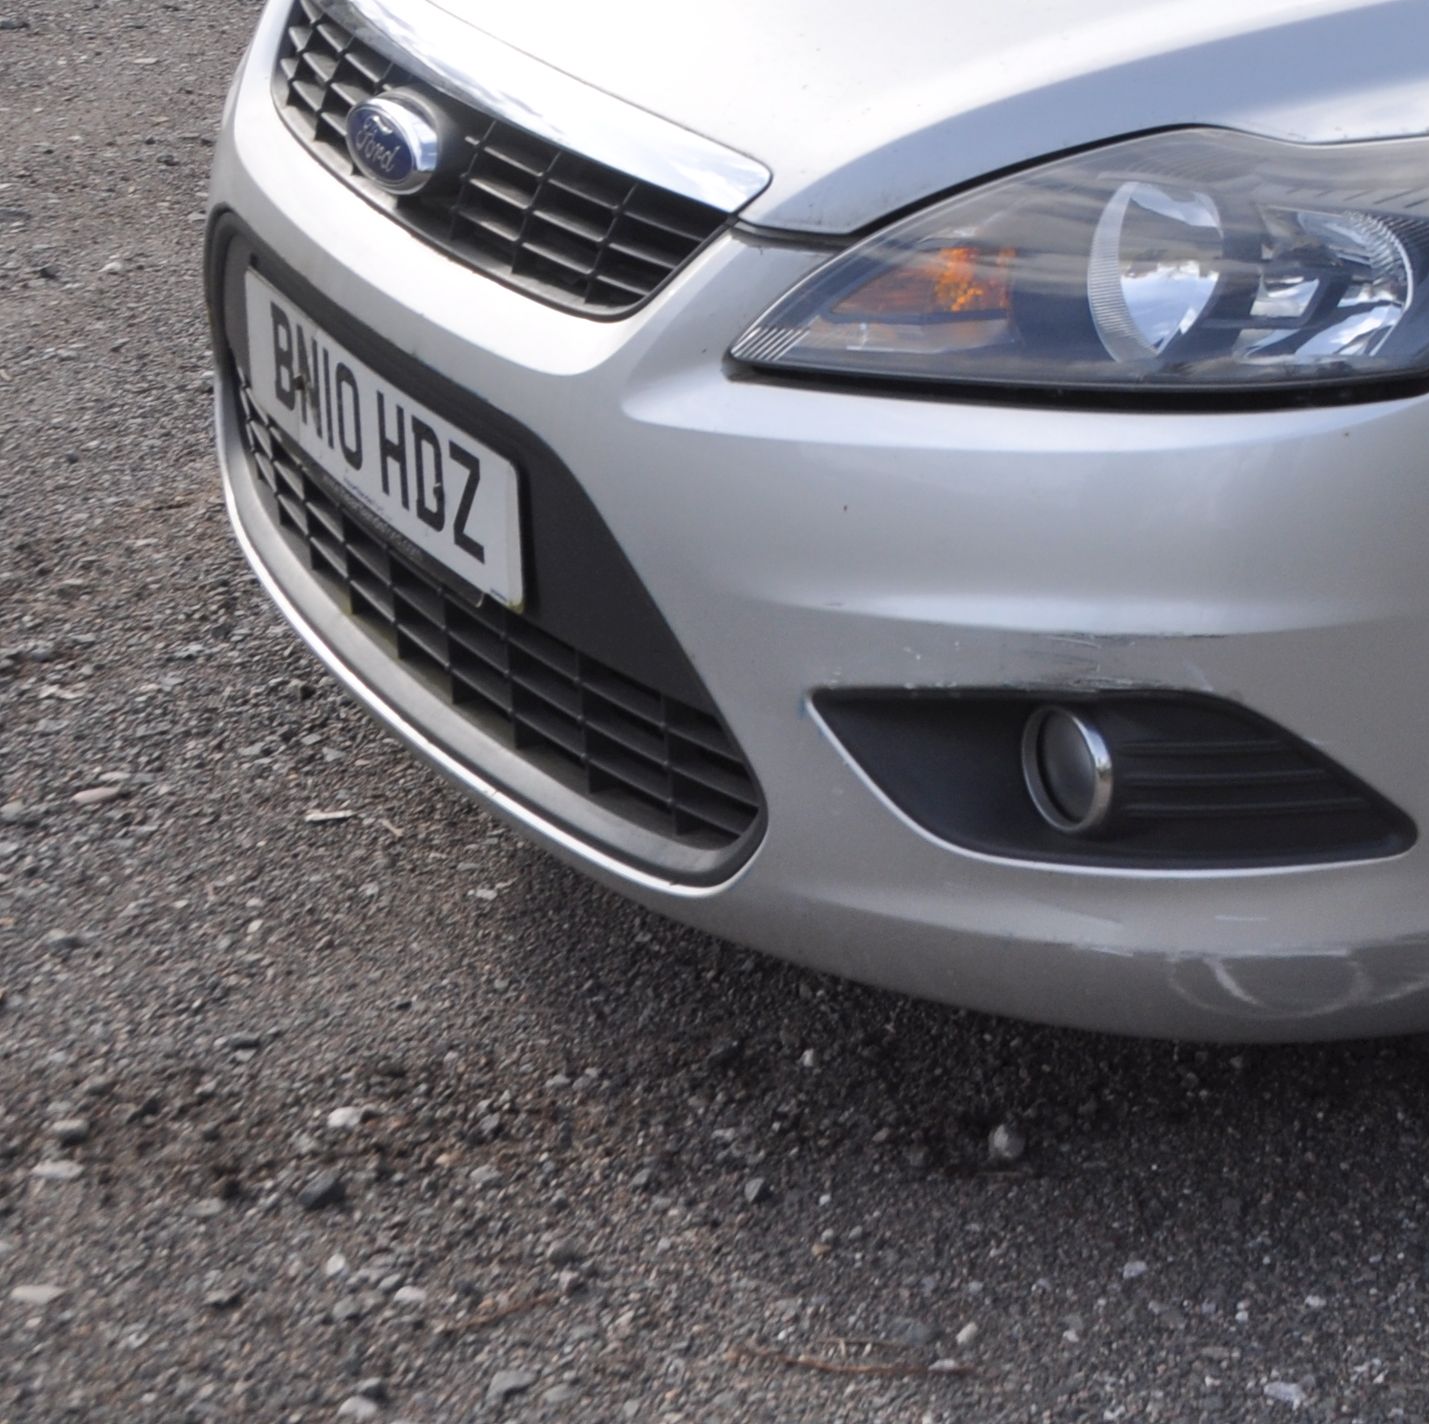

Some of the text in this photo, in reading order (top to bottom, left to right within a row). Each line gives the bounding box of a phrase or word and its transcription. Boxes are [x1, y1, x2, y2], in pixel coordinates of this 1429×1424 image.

[355, 116, 401, 173] Ford
[270, 300, 364, 471] BN10
[376, 389, 486, 565] HDZ
